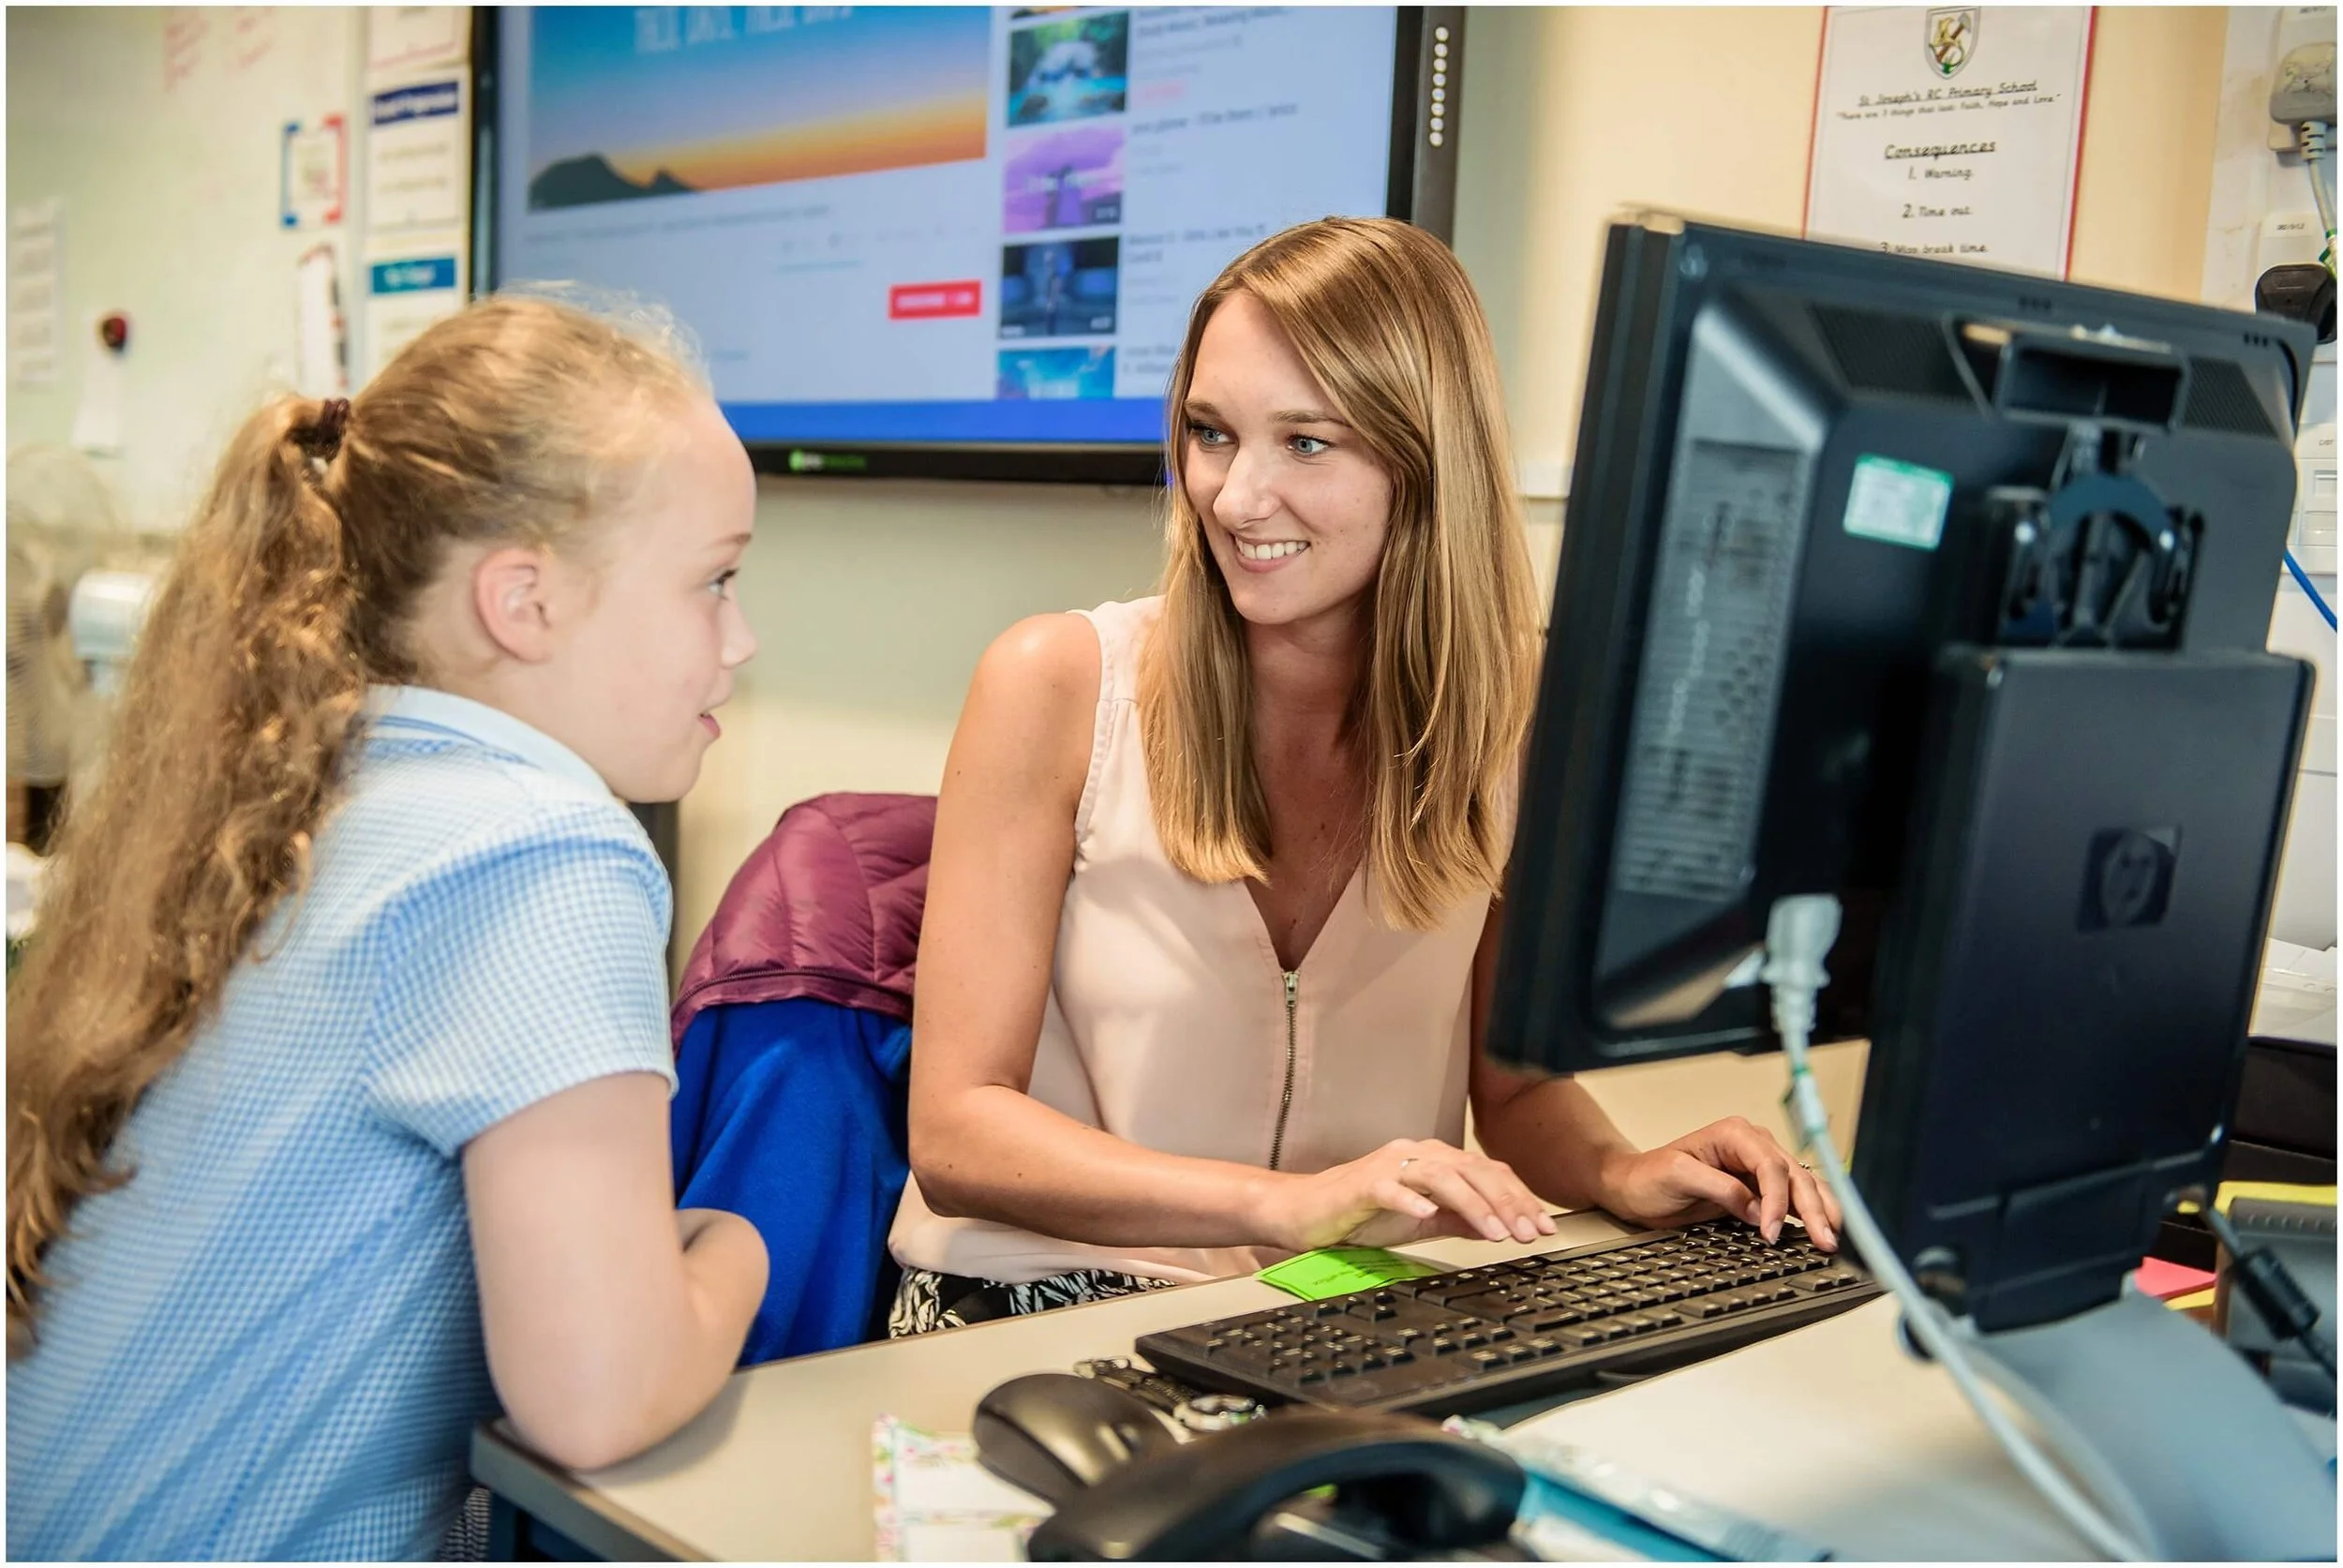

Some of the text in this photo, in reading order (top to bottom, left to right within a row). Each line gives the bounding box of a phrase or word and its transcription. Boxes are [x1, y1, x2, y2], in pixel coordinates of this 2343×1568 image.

[1928, 87, 1942, 99] RC
[1949, 86, 1992, 98] Primary
[1998, 79, 2037, 93] School
[2012, 96, 2030, 105] and
[1885, 142, 1996, 160] Consequences
[1918, 205, 1945, 217] Time
[1923, 242, 1954, 254] break
